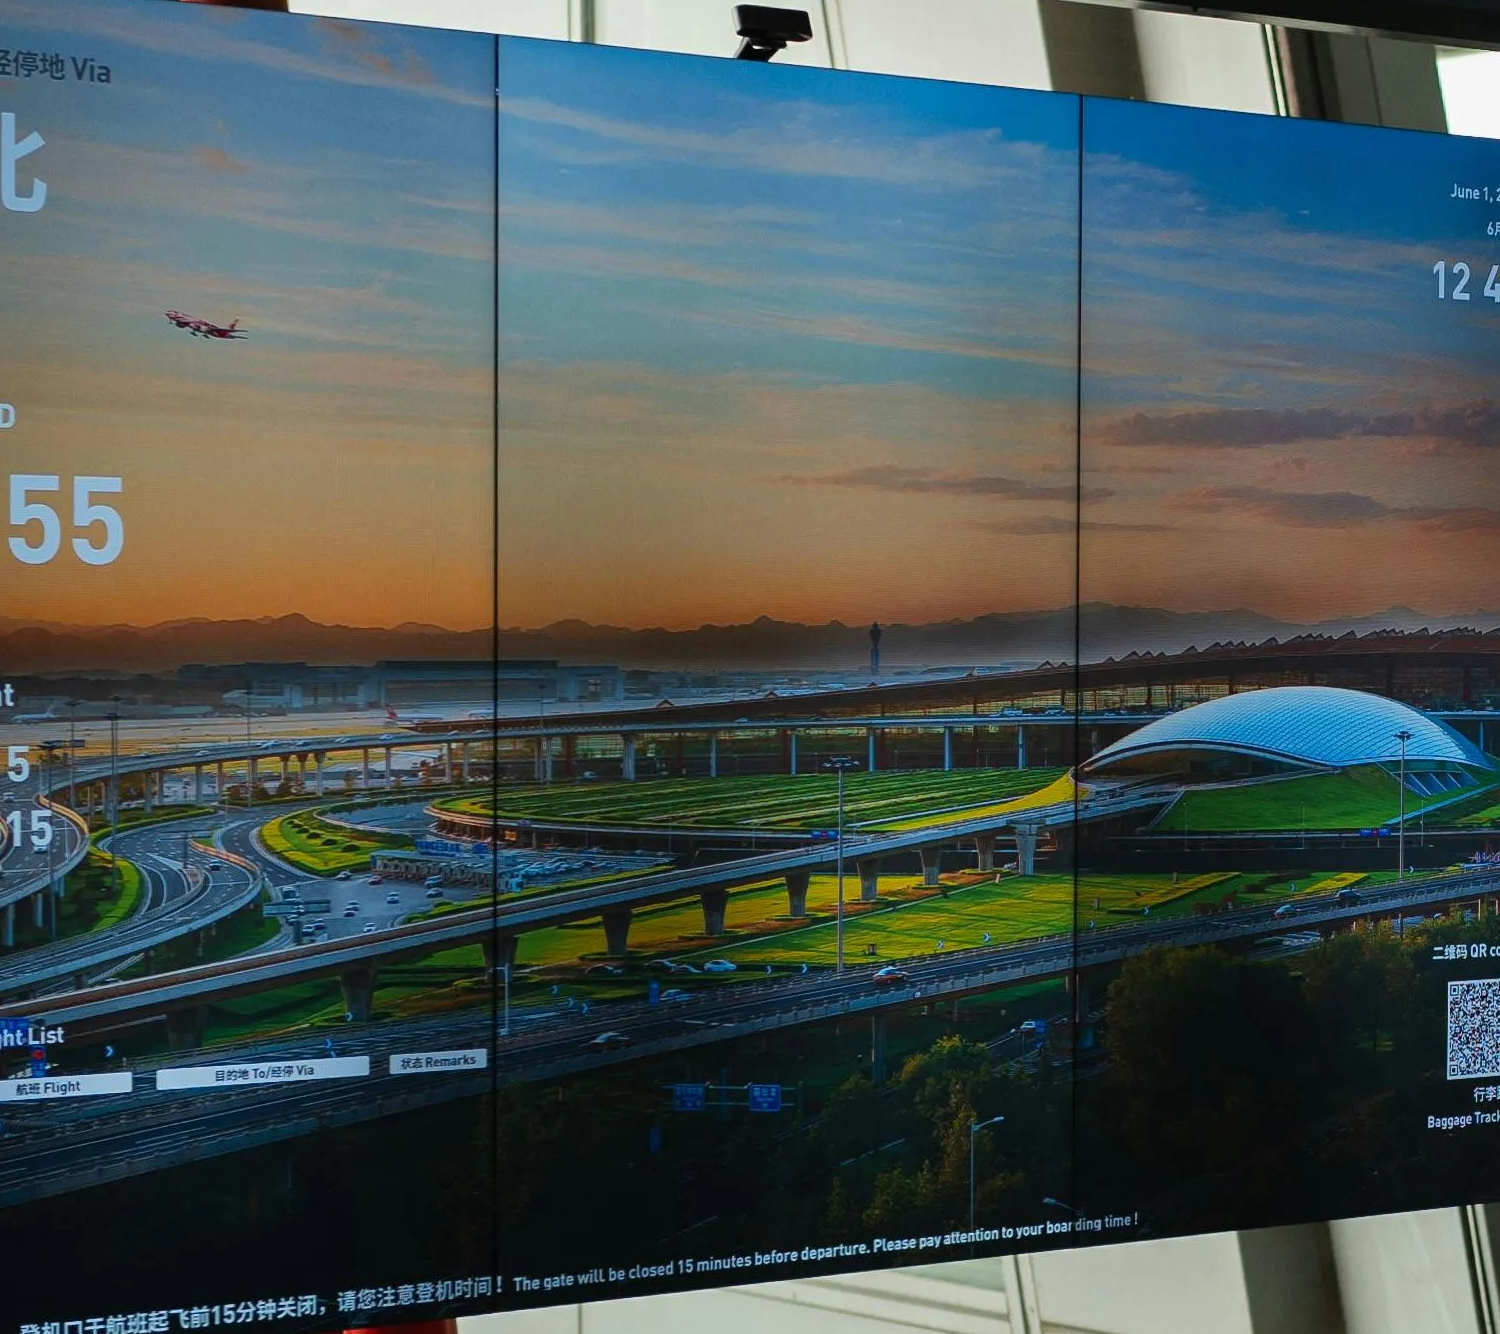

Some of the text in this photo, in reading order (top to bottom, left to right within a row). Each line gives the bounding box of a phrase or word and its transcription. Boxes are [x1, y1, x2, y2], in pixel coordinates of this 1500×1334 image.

[70, 56, 111, 84] Via
[1450, 183, 1480, 199] June
[1483, 187, 1493, 203] 1,
[1432, 944, 1468, 960] 二维码
[1470, 943, 1487, 958] QR
[28, 1026, 64, 1046] List
[401, 1055, 476, 1070] 状态 Remarks
[215, 1069, 250, 1082] 目的地
[296, 1065, 314, 1076] Via
[15, 1080, 81, 1096] 航班 Flight
[1427, 1113, 1472, 1129] Baggage
[512, 1276, 540, 1292] The
[544, 1274, 575, 1291] gate
[578, 1270, 605, 1286] will
[609, 1268, 625, 1281] be
[628, 1261, 673, 1279] closed
[678, 1259, 694, 1273] 15
[697, 1255, 751, 1273] minutes
[755, 1249, 798, 1265] before
[801, 1242, 871, 1263] departure.
[873, 1237, 916, 1253] Please
[919, 1235, 940, 1251] pay
[944, 1227, 999, 1247] attention
[1002, 1225, 1013, 1240] to
[1016, 1223, 1043, 1240] your
[1046, 1217, 1101, 1235] boarding
